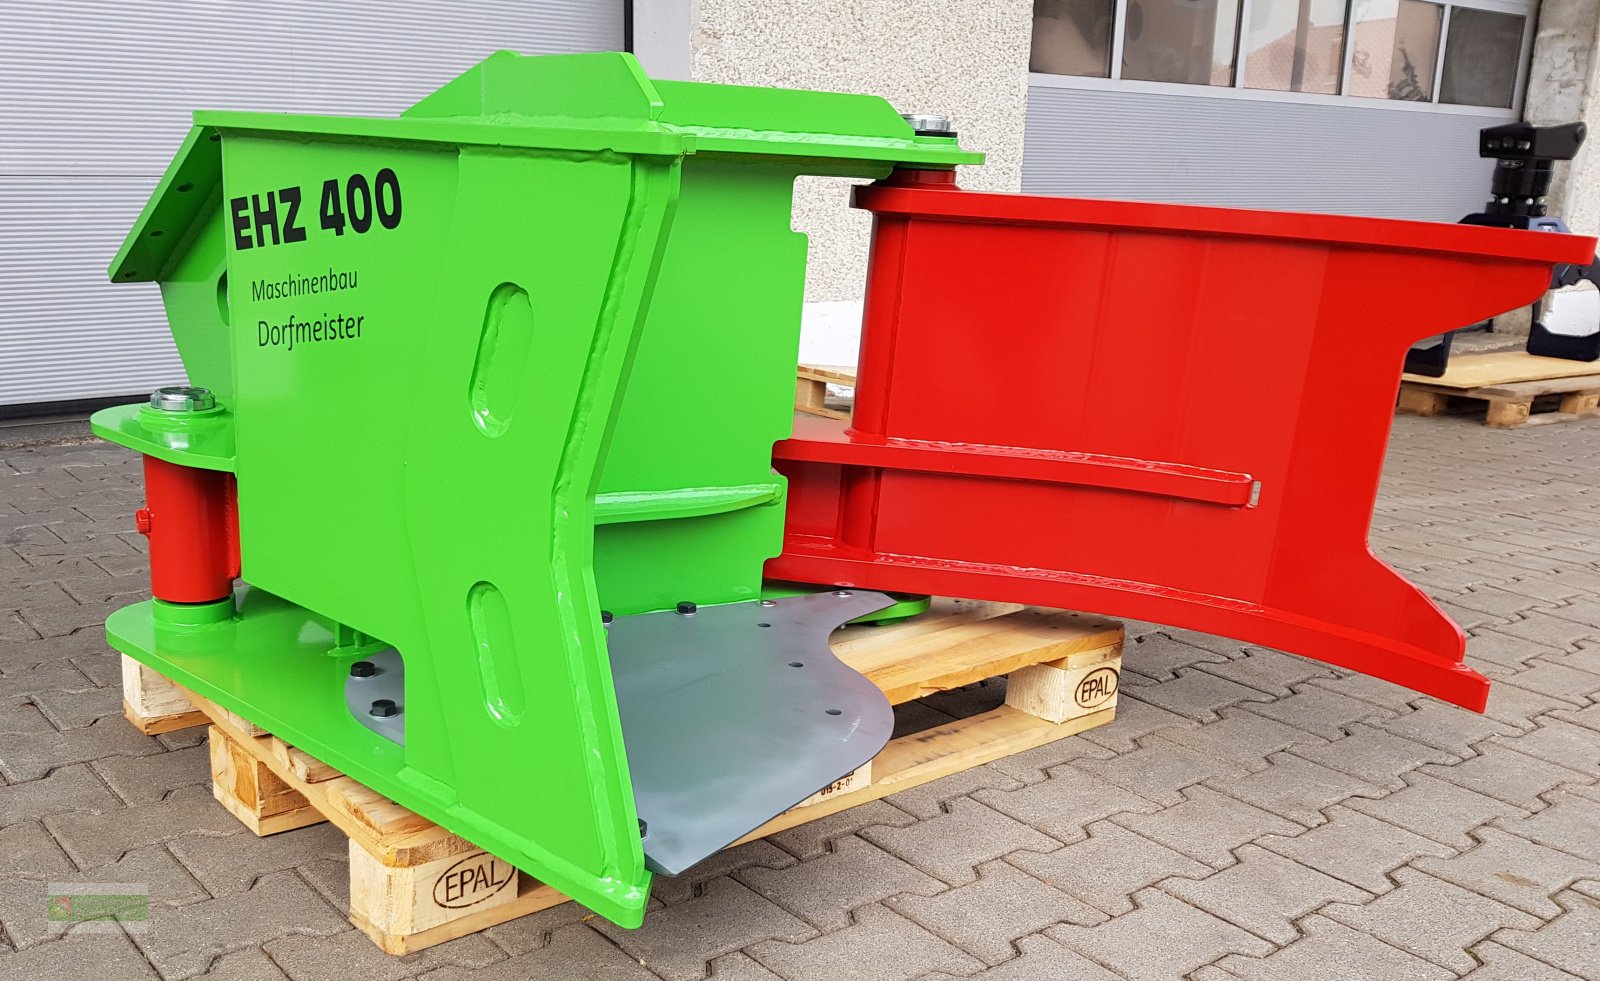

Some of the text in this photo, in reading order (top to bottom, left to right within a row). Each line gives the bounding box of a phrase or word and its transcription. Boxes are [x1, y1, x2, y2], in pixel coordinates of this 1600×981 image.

[230, 168, 402, 250] EHZ 400
[252, 267, 358, 302] Maschinenbau
[258, 313, 364, 351] Dorfmeister
[1081, 675, 1111, 702] EPAL
[445, 860, 504, 902] EPAL
